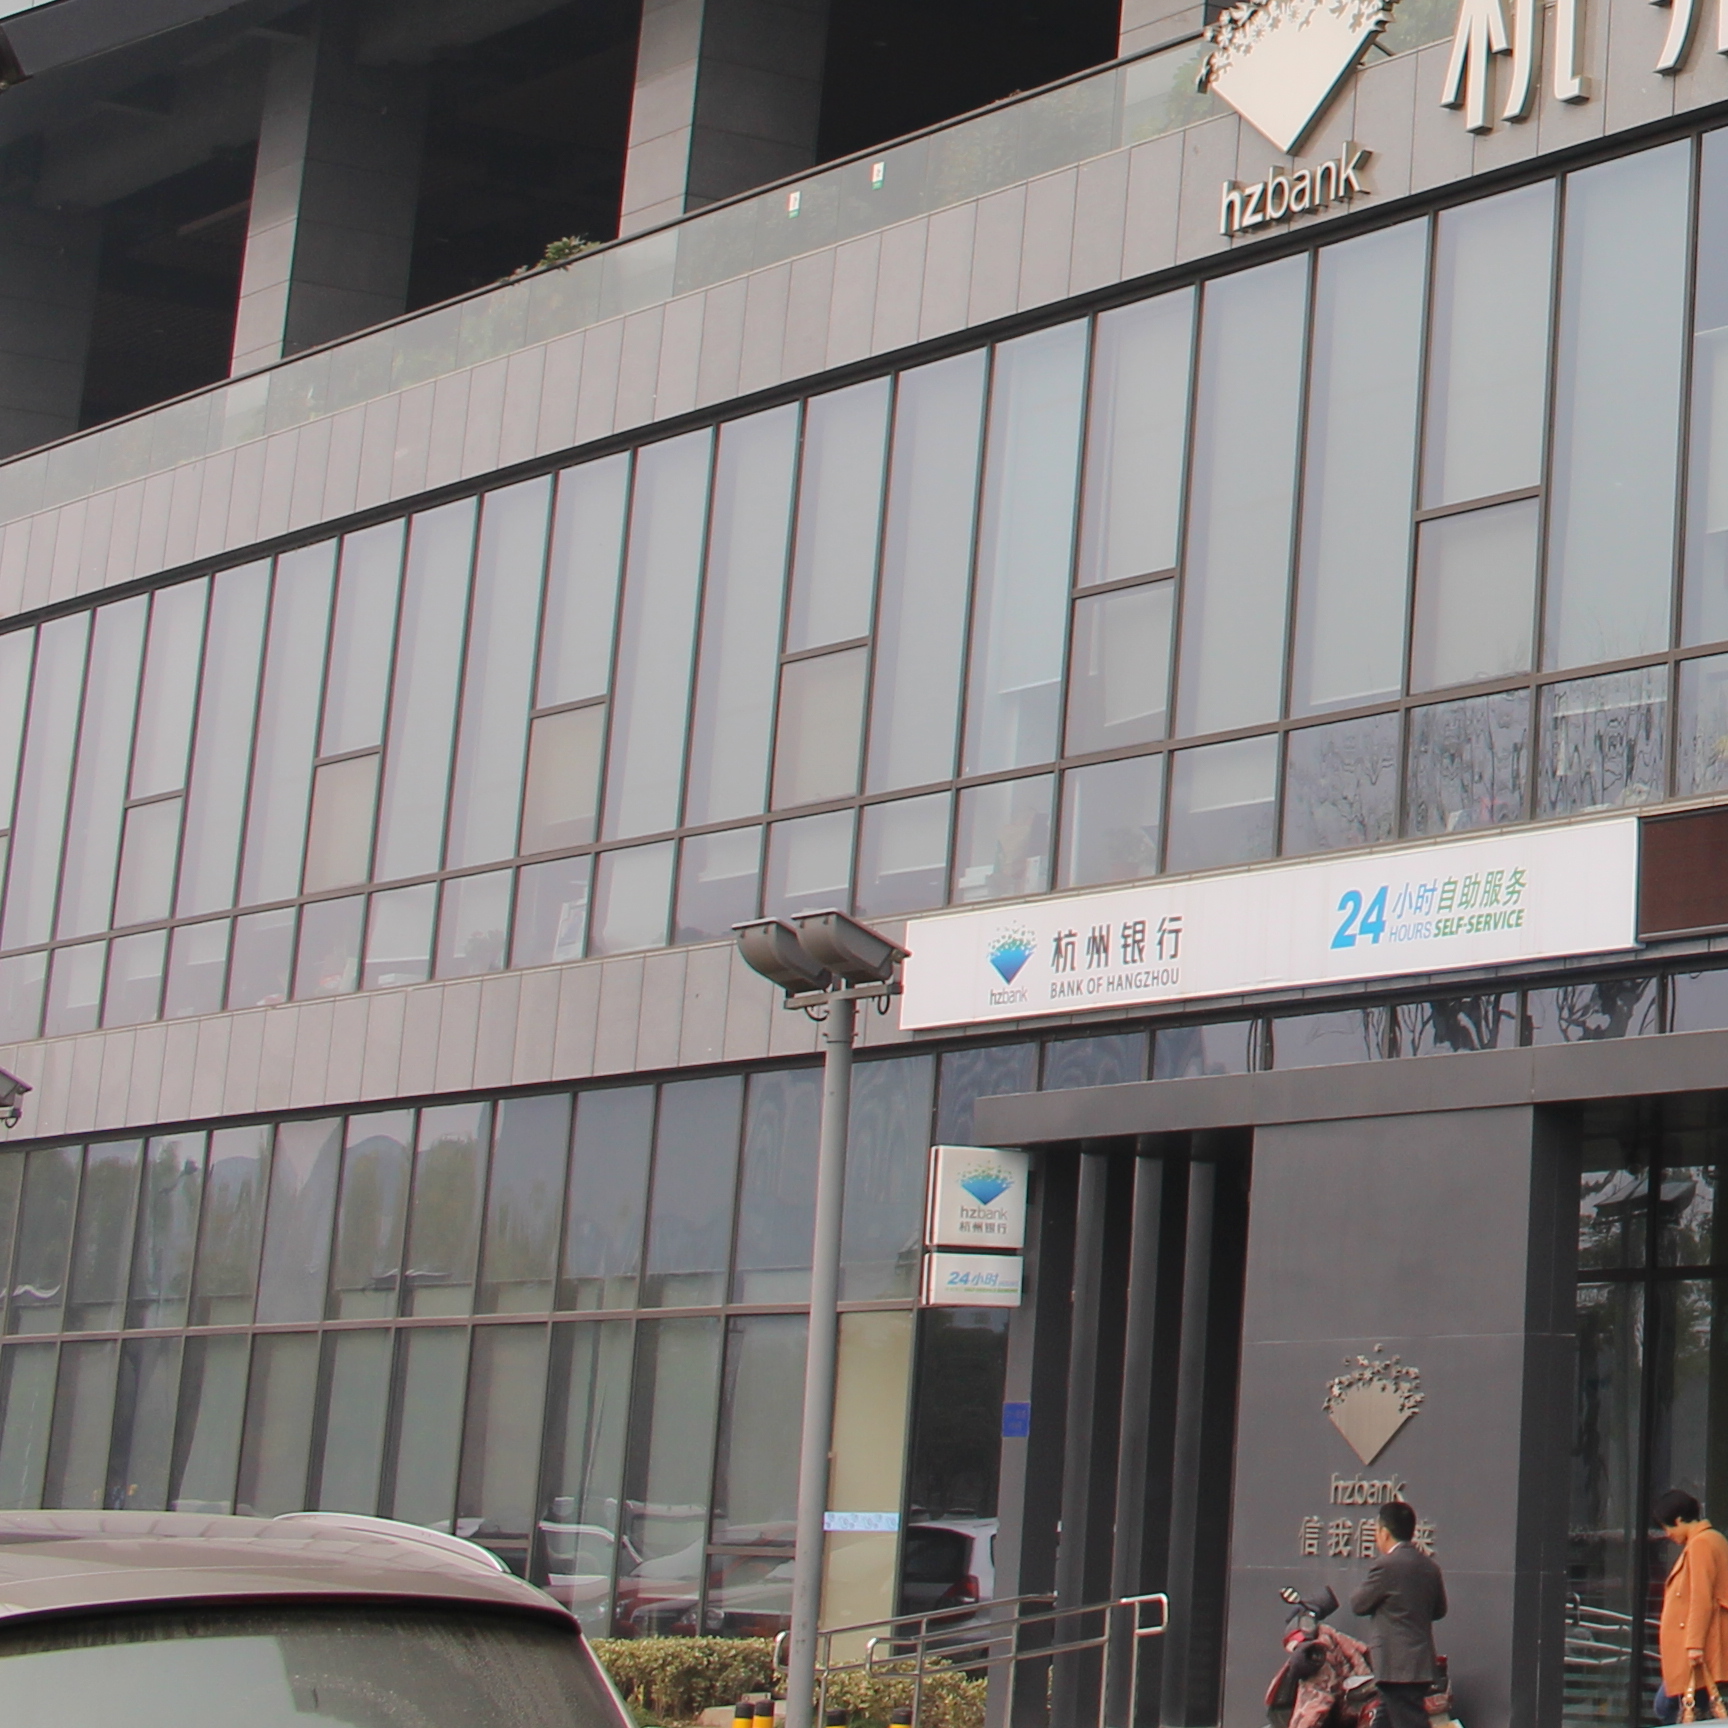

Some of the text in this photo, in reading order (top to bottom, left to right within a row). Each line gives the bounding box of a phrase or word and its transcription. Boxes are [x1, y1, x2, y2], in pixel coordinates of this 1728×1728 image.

[1219, 141, 1374, 237] hzbank
[1330, 885, 1389, 950] 24
[1389, 908, 1525, 943] HOURS SELF-SERVICE
[1051, 915, 1183, 974] 杭州银行
[989, 986, 1028, 1005] hzbank
[1049, 967, 1180, 999] BANK OF HANGZHOU
[960, 1205, 1008, 1220] hzbank
[1329, 1472, 1406, 1504] hzbank
[1299, 1515, 1437, 1558] 信我信来
